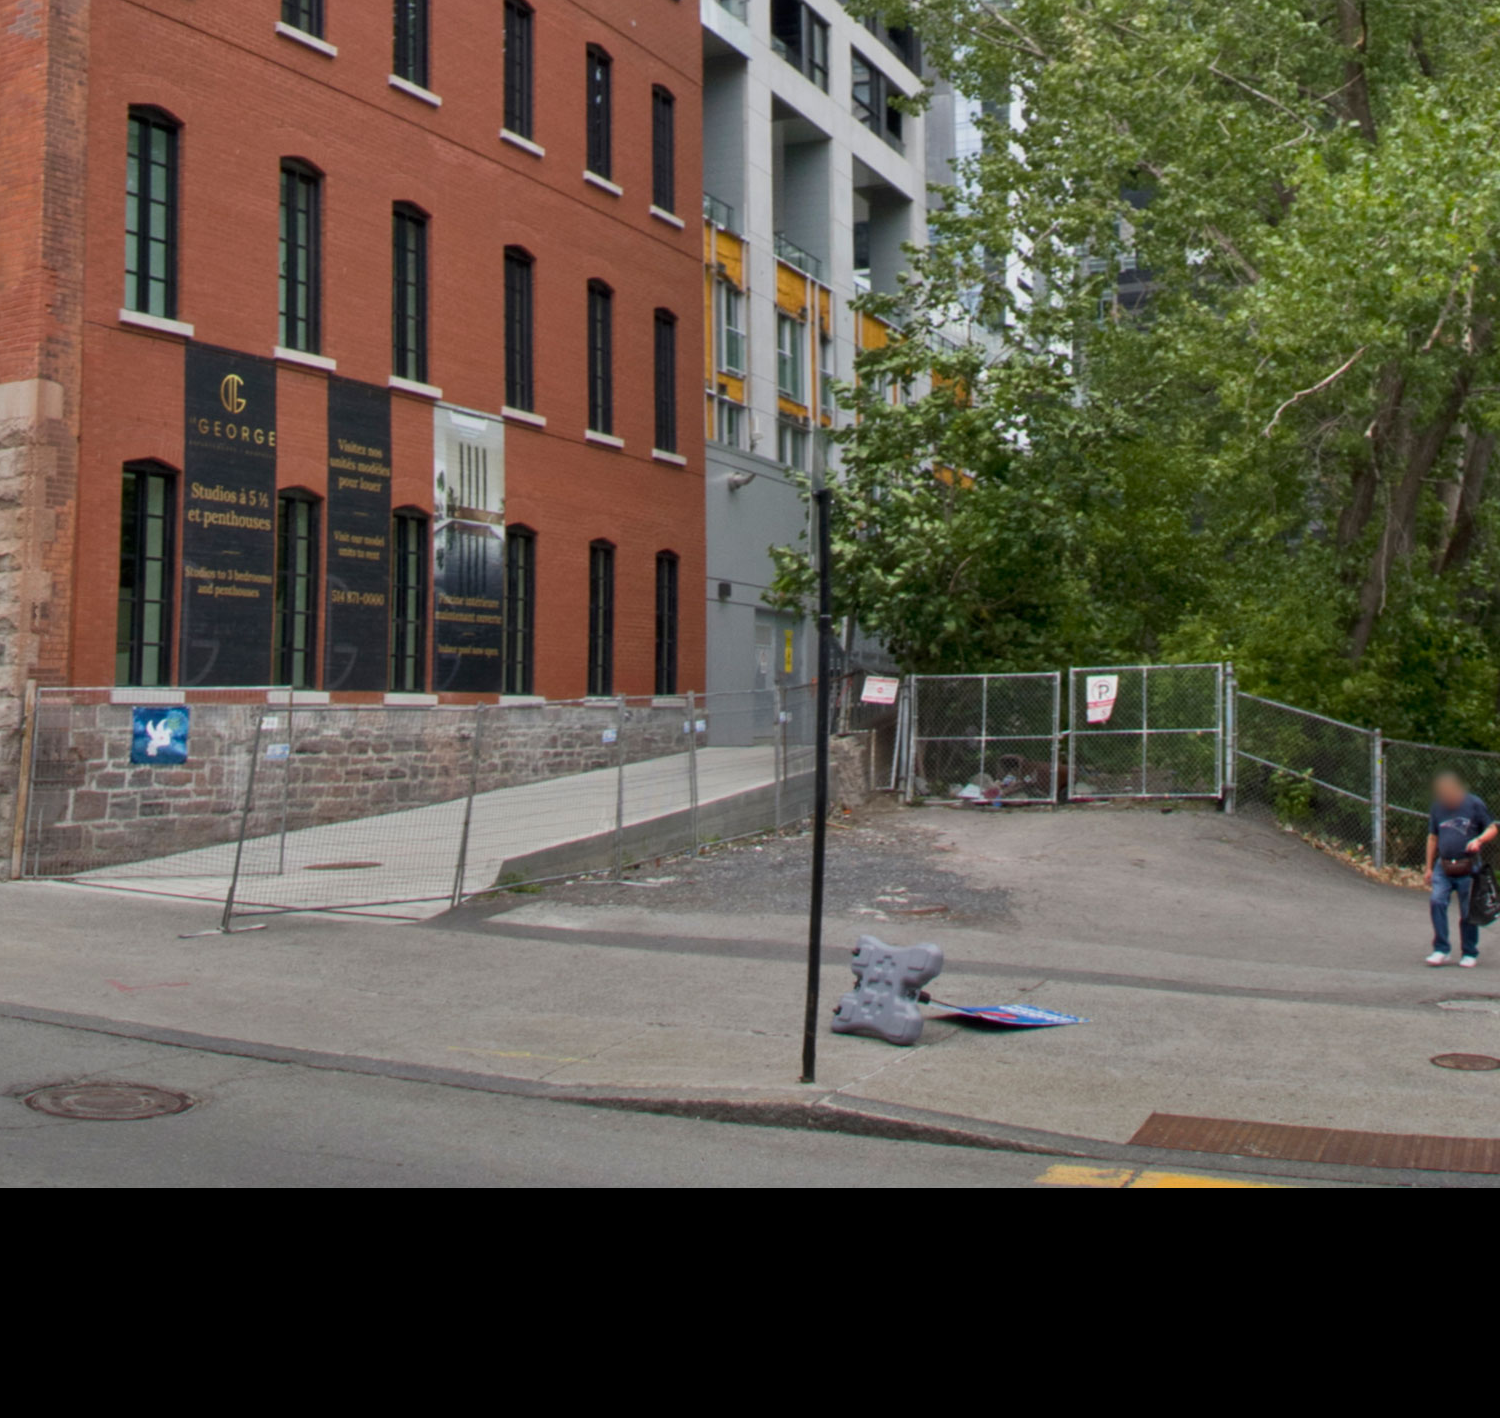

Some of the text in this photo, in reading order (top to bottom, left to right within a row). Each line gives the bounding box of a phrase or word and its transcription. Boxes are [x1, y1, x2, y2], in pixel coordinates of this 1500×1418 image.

[198, 418, 276, 447] GEORGE
[338, 438, 383, 459] Visitez nos
[330, 456, 391, 477] unités modèles
[191, 482, 237, 503] Studios
[240, 488, 247, 504] à
[249, 490, 256, 506] 5
[338, 476, 382, 493] pour louer
[187, 508, 272, 531] et penthouses
[333, 530, 350, 542] Visit
[363, 535, 385, 547] model
[185, 565, 272, 585] Studios to 3 bedrooms
[197, 582, 260, 598] and penthouses
[331, 590, 345, 603] 514
